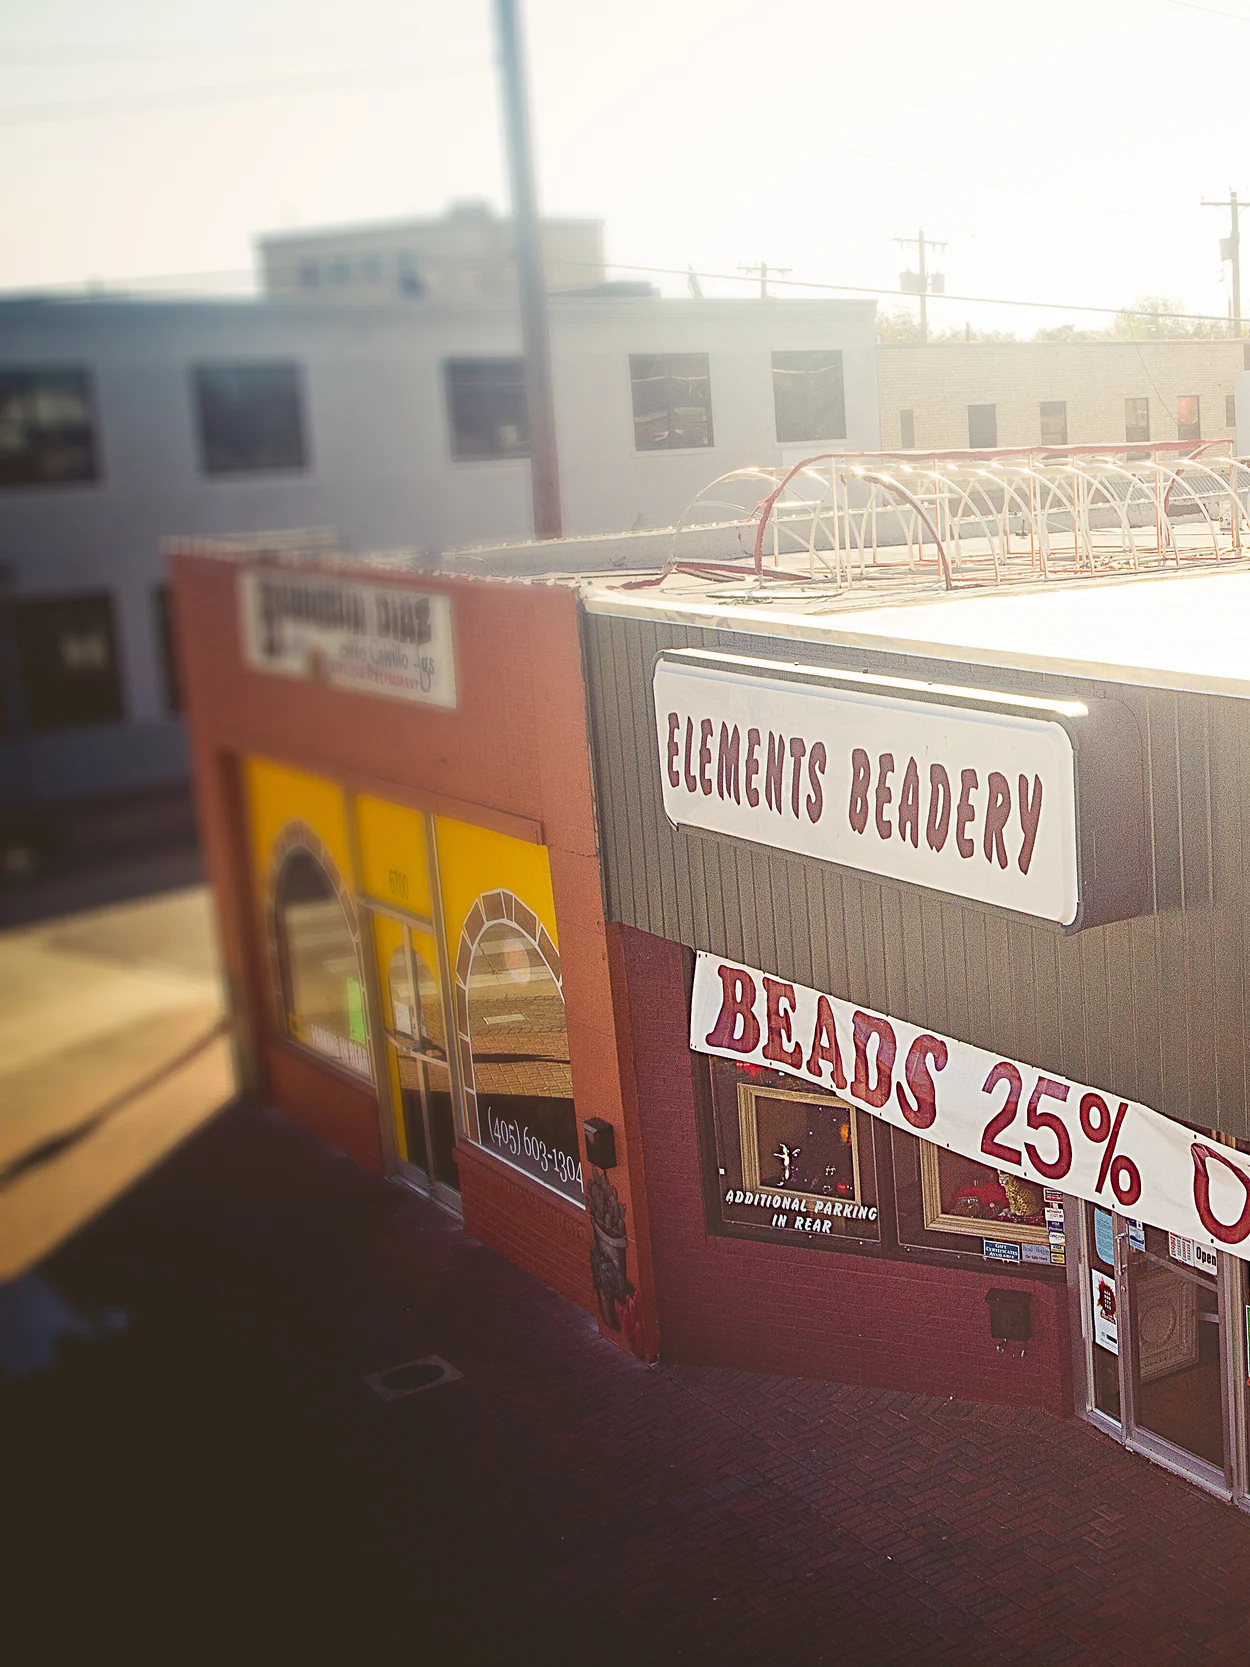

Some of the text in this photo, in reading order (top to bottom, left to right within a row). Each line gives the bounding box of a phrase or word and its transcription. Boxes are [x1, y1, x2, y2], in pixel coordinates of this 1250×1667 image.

[667, 712, 1043, 876] ELEMENTS BEADERY
[705, 964, 948, 1130] BEADS
[980, 1061, 1142, 1206] 25%
[488, 1106, 584, 1194] (405) 603-1304
[725, 1189, 878, 1221] ADDITIONAL PARKING
[771, 1214, 832, 1233] IN REAR
[1196, 1246, 1217, 1267] Open
